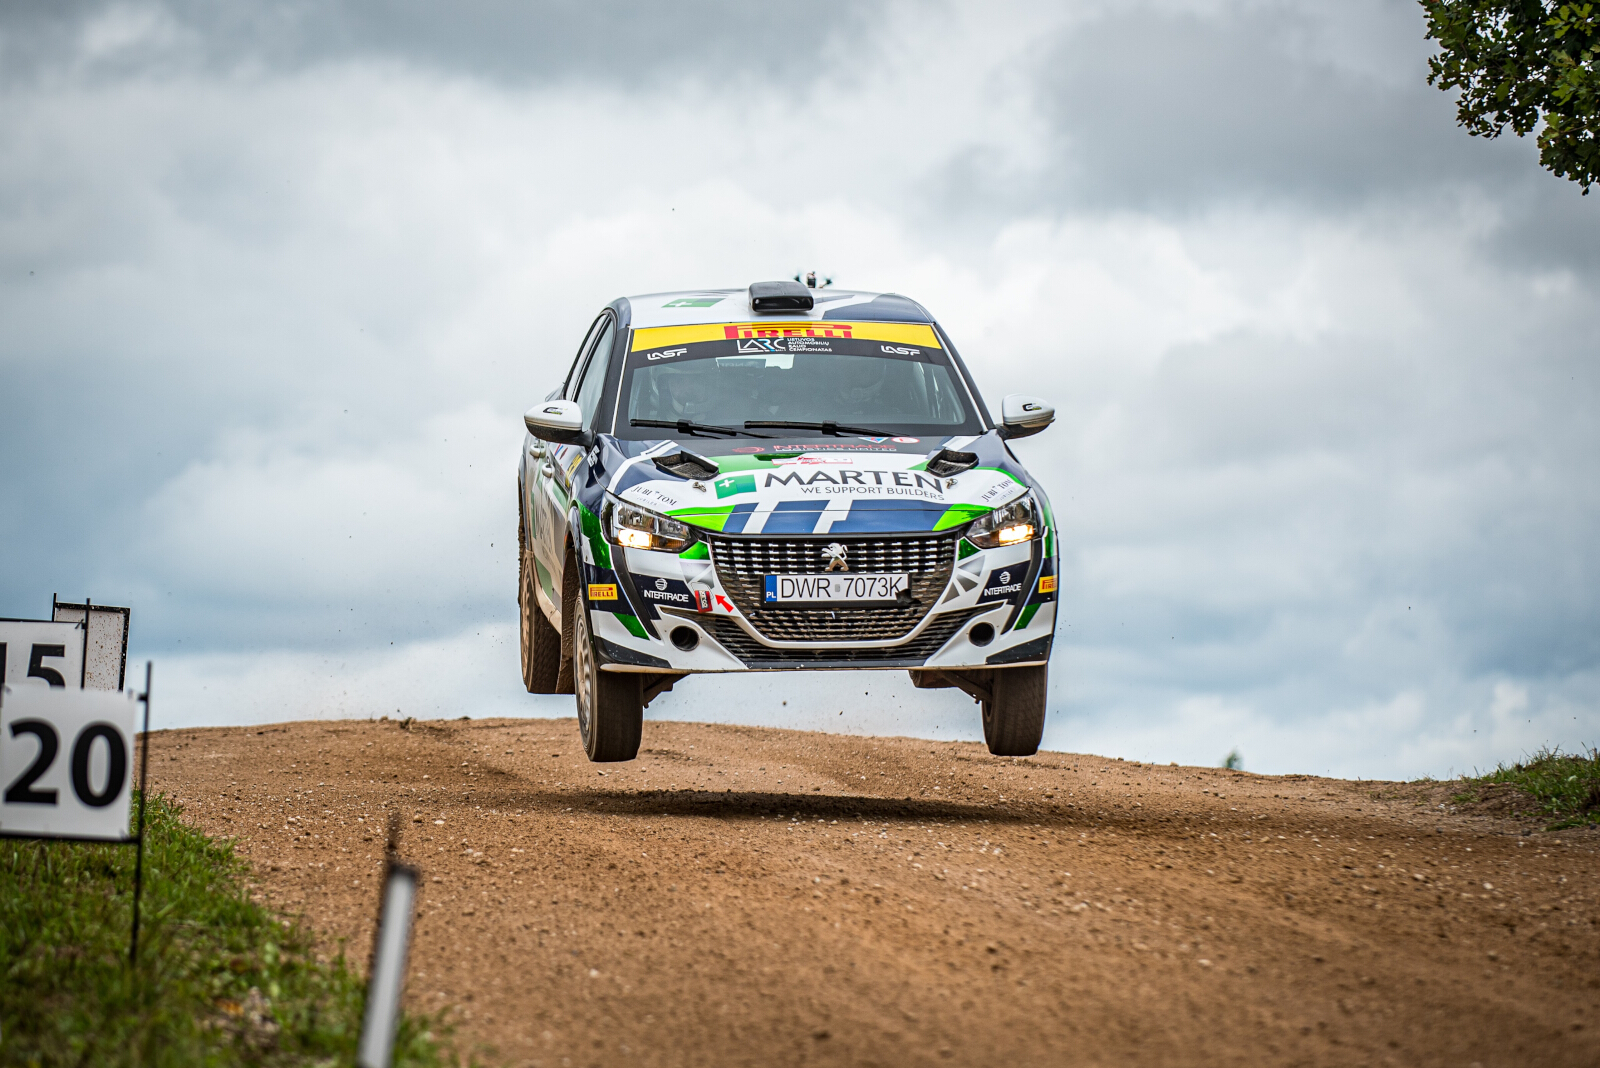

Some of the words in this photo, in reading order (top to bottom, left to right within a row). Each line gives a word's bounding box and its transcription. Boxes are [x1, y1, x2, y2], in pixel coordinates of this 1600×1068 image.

[724, 322, 852, 339] PIRELLI
[647, 348, 687, 361] LASF
[880, 344, 920, 356] LASF
[764, 470, 944, 493] MARTEN
[631, 485, 653, 496] JUBI
[656, 493, 678, 506] TOM
[824, 486, 881, 494] SUPPORT
[887, 487, 944, 501] BUILDERS
[590, 586, 614, 598] PIRELLI
[766, 591, 777, 599] PL
[781, 578, 832, 598] DWR
[843, 576, 904, 599] 7073K
[984, 582, 1022, 597] INTERTRADE
[643, 589, 689, 603] INTERTRADE
[4, 718, 128, 808] 20
